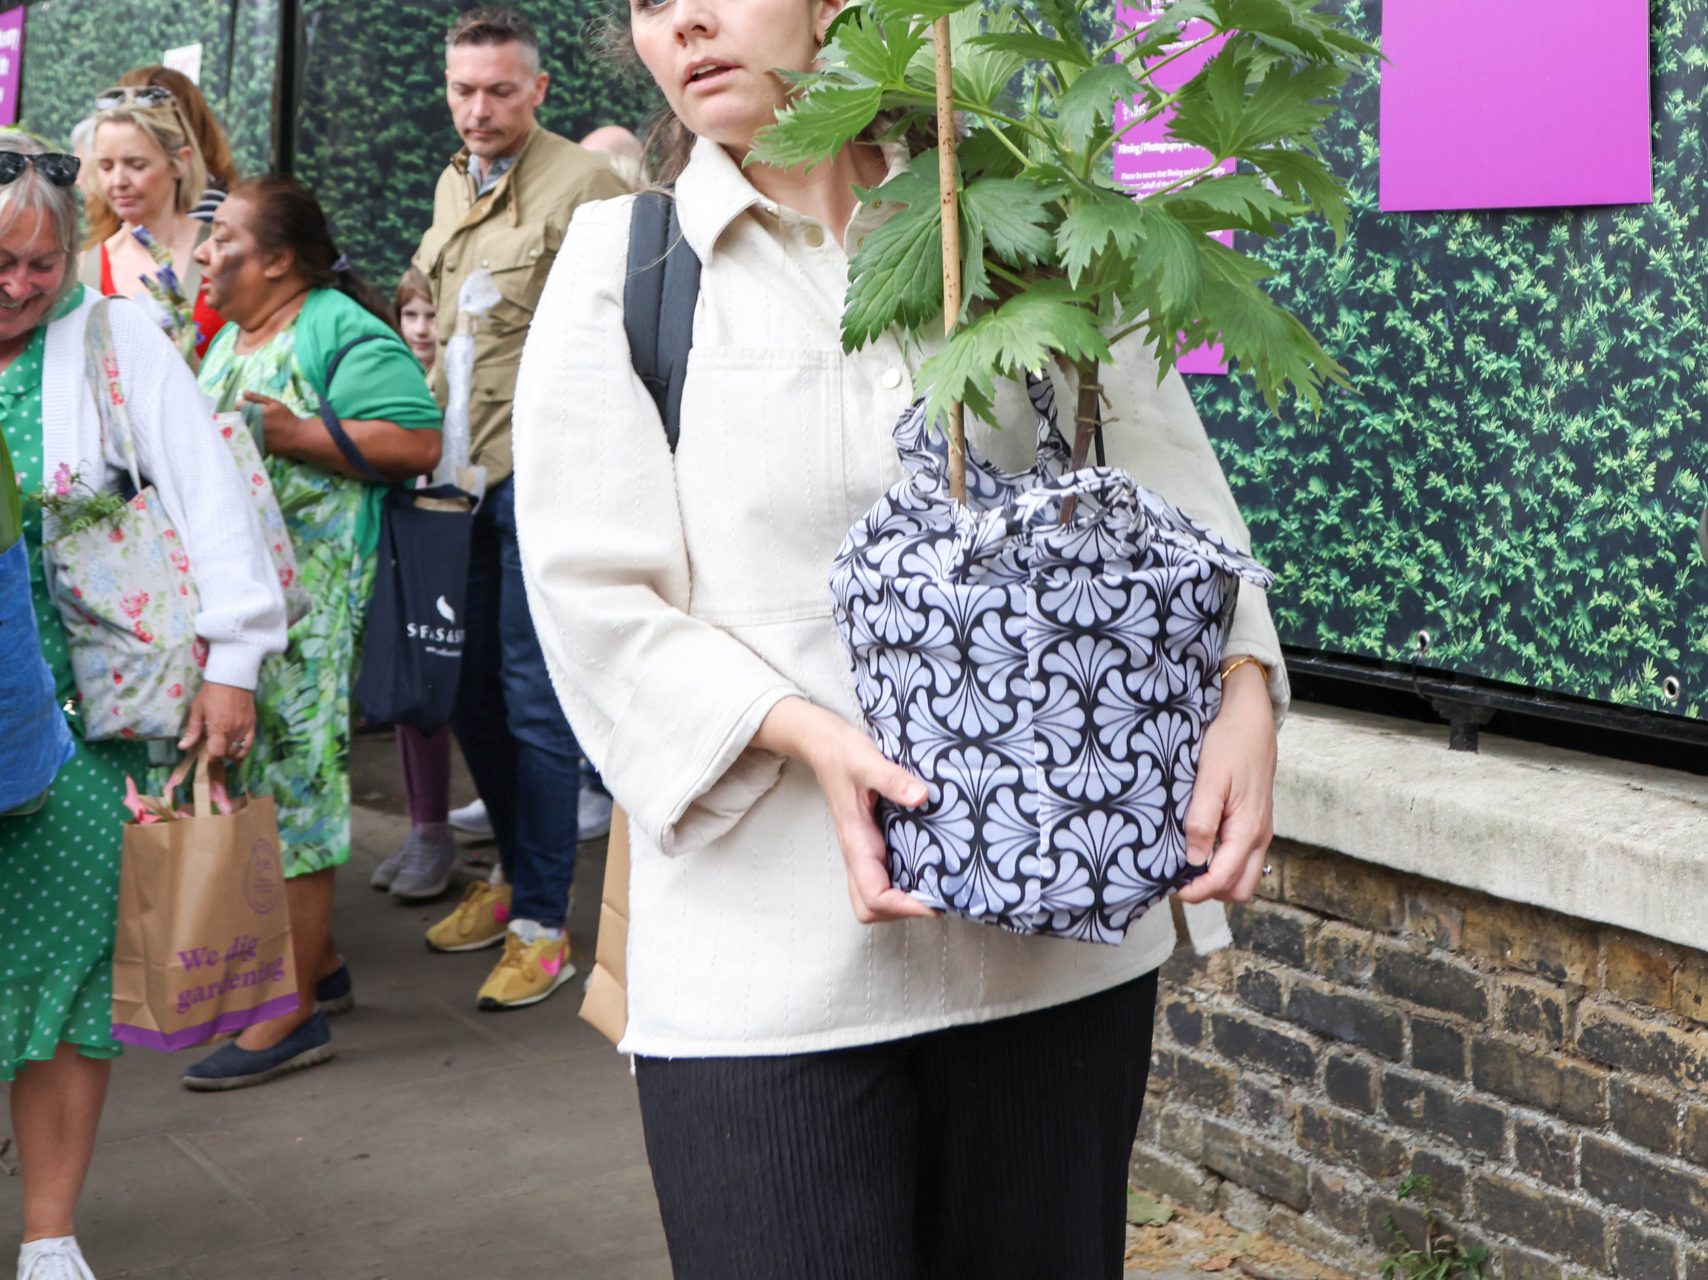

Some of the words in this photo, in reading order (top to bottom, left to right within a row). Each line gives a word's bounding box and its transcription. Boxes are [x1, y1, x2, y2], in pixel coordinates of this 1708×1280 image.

[176, 946, 218, 972] We
[224, 934, 261, 962] dig
[176, 956, 285, 1015] gardening
